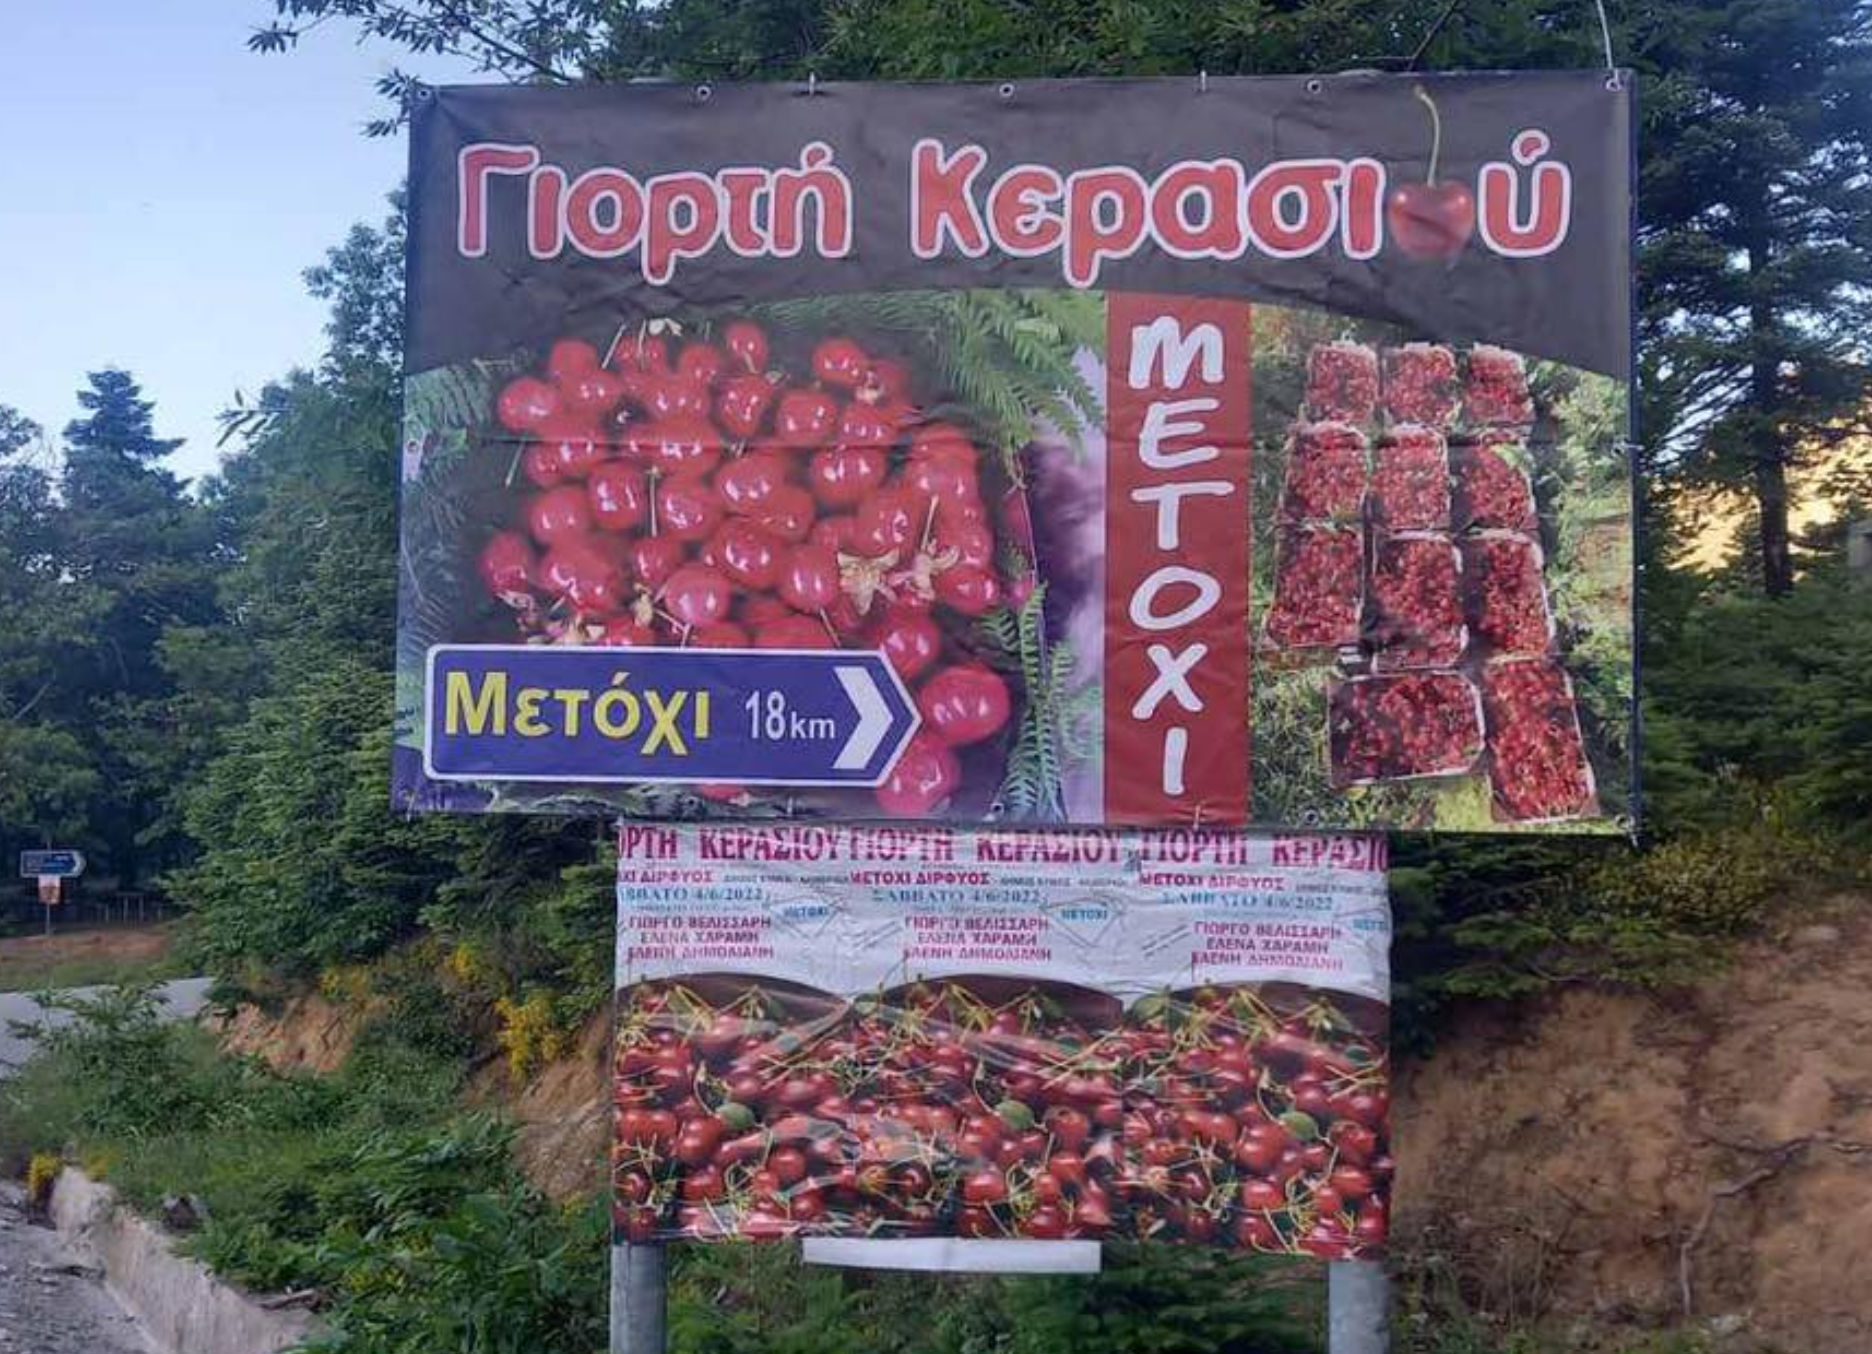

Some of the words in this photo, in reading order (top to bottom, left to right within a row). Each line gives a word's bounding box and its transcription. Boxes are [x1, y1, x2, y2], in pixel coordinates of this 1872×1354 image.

[458, 140, 853, 286] Γιορτή
[1128, 316, 1235, 796] ΜΕΤΟΧΙ
[444, 671, 710, 757] Μετόχι
[700, 827, 840, 861] ΚΕΡΑΣΙΟΥ
[850, 827, 955, 861] ΓΙΟΡΤΗ
[976, 829, 1121, 863] ΚΕΡΑΣΙΟΥ
[1139, 827, 1247, 865] ΓΙΟΡΤΗ
[850, 870, 911, 885] ΜΕΤΟΧΙ
[916, 871, 990, 885] ΔΙΡΦΥΟΣ
[1140, 873, 1203, 887] ΜΕΤΟΧΙ
[872, 889, 965, 902] ΣΑΒΒΑΤΟ
[689, 915, 771, 929] ΒΕΛΙΣΣΑΡΗ
[964, 917, 1049, 931] ΒΕΛΙΣΣΑΡΗ
[641, 932, 690, 944] ΕΛΕΝΑ
[1256, 923, 1342, 939] ΒΕΛΙΣΣΑΡΗ
[1206, 937, 1256, 951] ΕΛΕΝΑ
